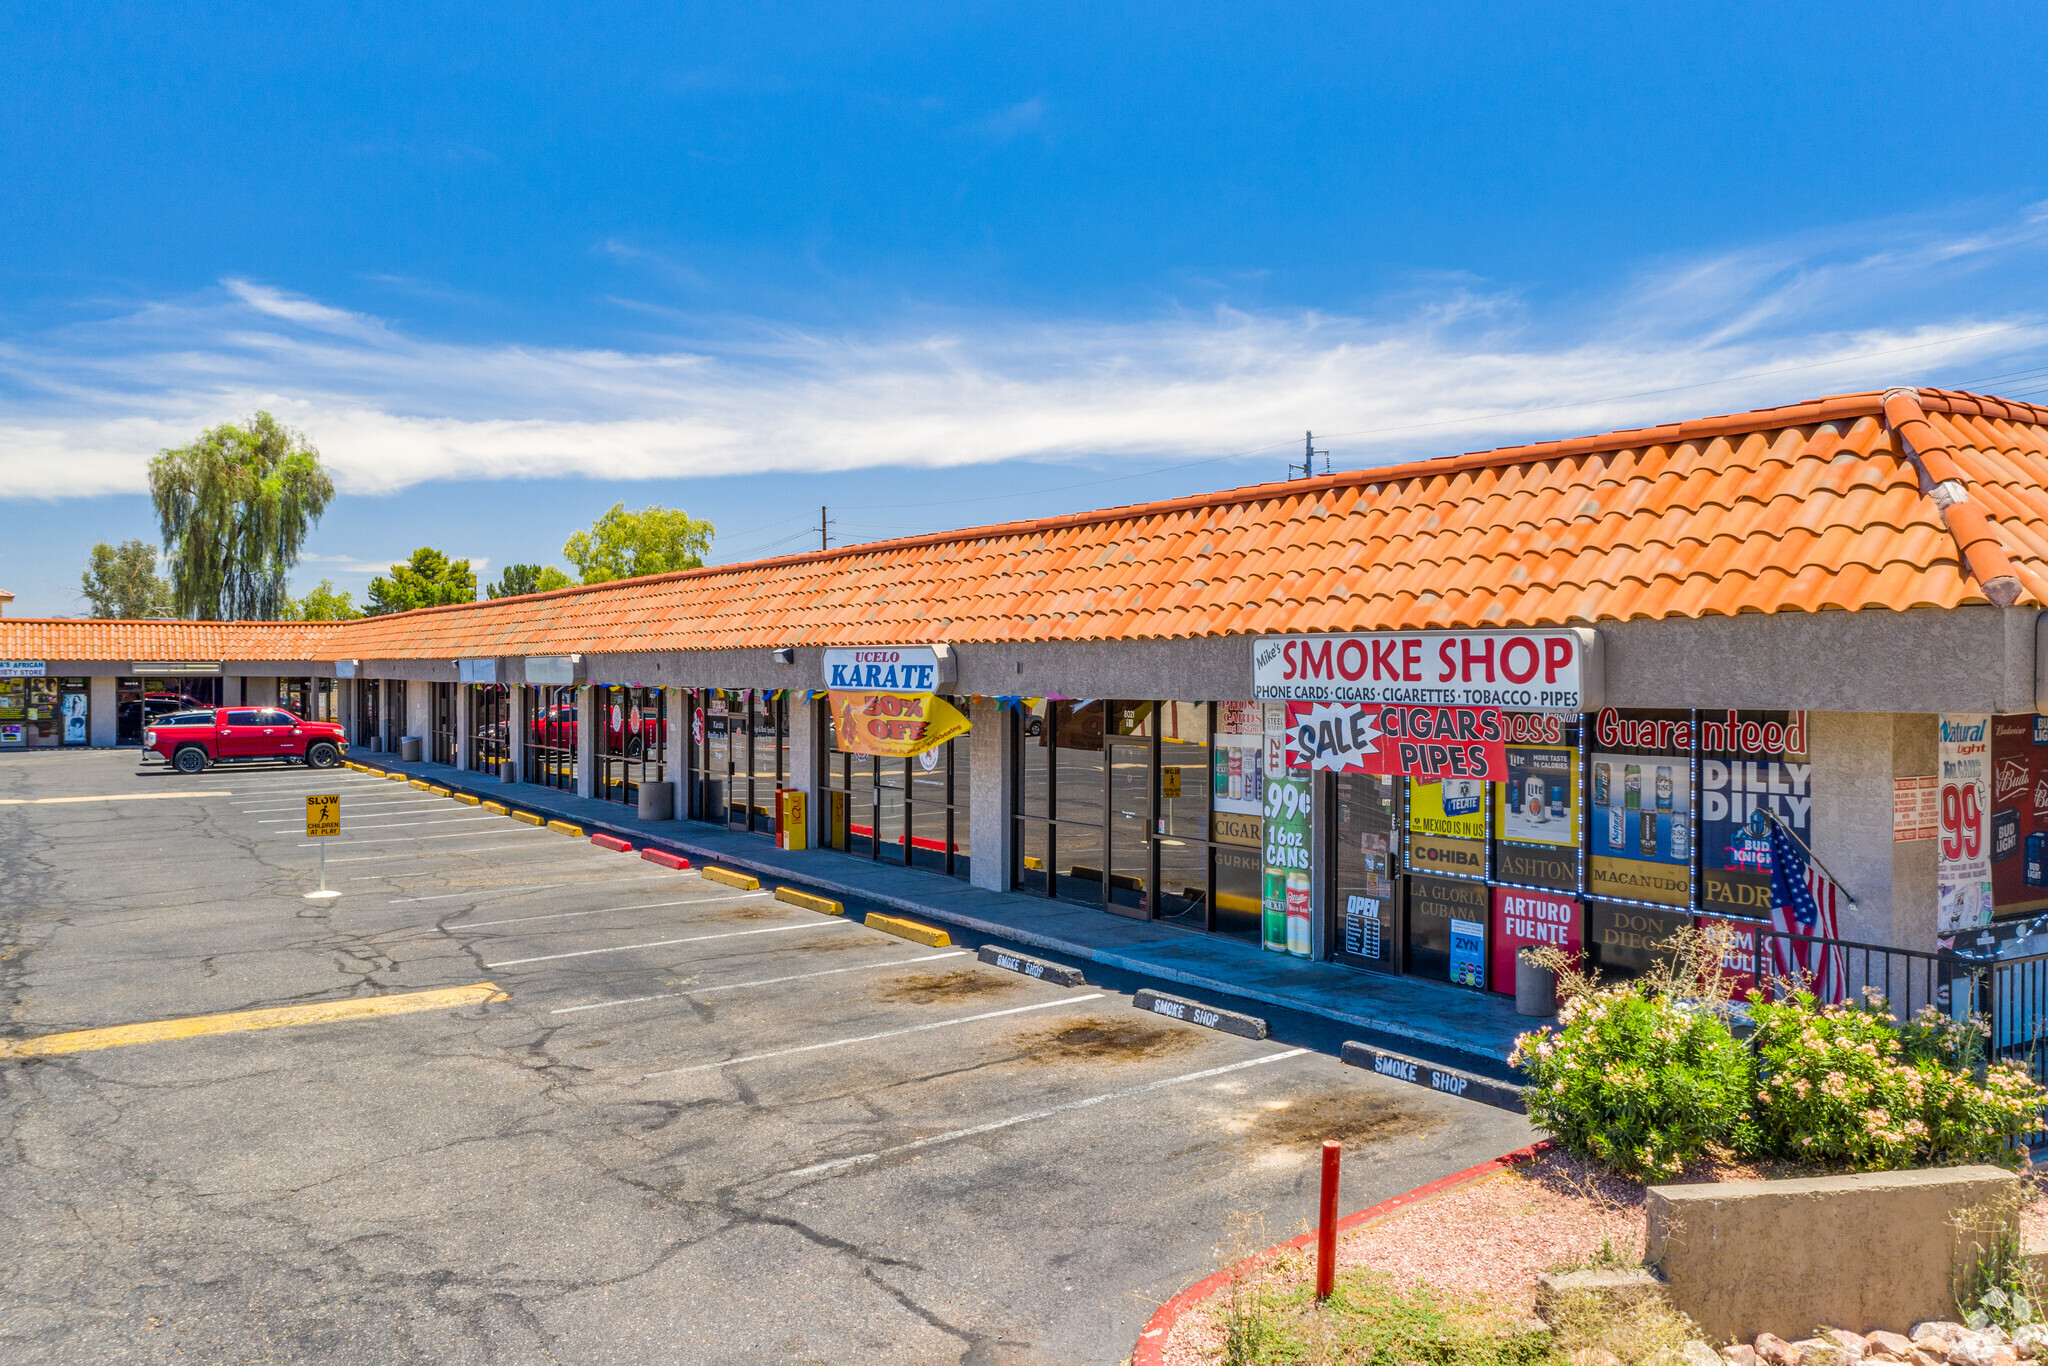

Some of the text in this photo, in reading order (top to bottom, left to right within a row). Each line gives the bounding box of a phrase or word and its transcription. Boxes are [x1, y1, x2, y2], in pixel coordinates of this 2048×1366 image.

[855, 651, 900, 663] UCELO
[1255, 643, 1281, 671] Mike's
[1282, 637, 1574, 684] SMOKE SHOP
[830, 663, 934, 690] KARATE
[862, 695, 924, 718] 50%
[1256, 685, 1579, 707] PHONE CARDS CIGARS CIGARETTES TOBACCO PIPES
[1223, 711, 1263, 724] CARDS
[1267, 717, 1284, 725] STEEL
[1379, 707, 1501, 742] CIGARS
[867, 719, 931, 741] OFF
[1298, 710, 1368, 763] SALE
[1596, 706, 1807, 754] Guaranteed
[1939, 719, 1987, 743] Natural
[1994, 724, 2026, 736] Budweiser
[1268, 738, 1281, 773] 211
[1399, 742, 1489, 778] PIPES
[1540, 762, 1568, 770] CALORIES
[1702, 759, 1811, 795] DILLY
[308, 796, 339, 805] SLOW
[1527, 783, 1543, 797] Lite
[1451, 796, 1478, 811] TECATE
[1215, 820, 1261, 841] CIGAR
[1423, 818, 1484, 837] MEXICO IS IN US
[1998, 822, 2015, 839] BUD
[1744, 839, 1770, 852] BUD
[1996, 834, 2017, 853] LIGHT
[1214, 853, 1260, 871] GURKH
[1266, 845, 1309, 869] CANS
[1414, 846, 1480, 867] COHIBA
[1501, 855, 1575, 880] ASHTON
[1593, 869, 1689, 893] MACANUDO
[1409, 882, 1428, 898] LA
[1431, 885, 1486, 907] GLORIA
[1706, 880, 1772, 909] PADR
[1347, 895, 1380, 918] OPEN
[1420, 901, 1476, 922] CUBANA
[1504, 896, 1571, 924] ARTURO
[1505, 916, 1569, 945] FUENTE
[1613, 912, 1665, 934] DON
[1455, 937, 1479, 952] ZYN
[1603, 928, 1677, 954] DIEGO
[996, 954, 1044, 979] SMOKE SHOP
[1153, 998, 1219, 1028] SMOKE SHOP
[1374, 1056, 1468, 1095] SMOKE SHOP
